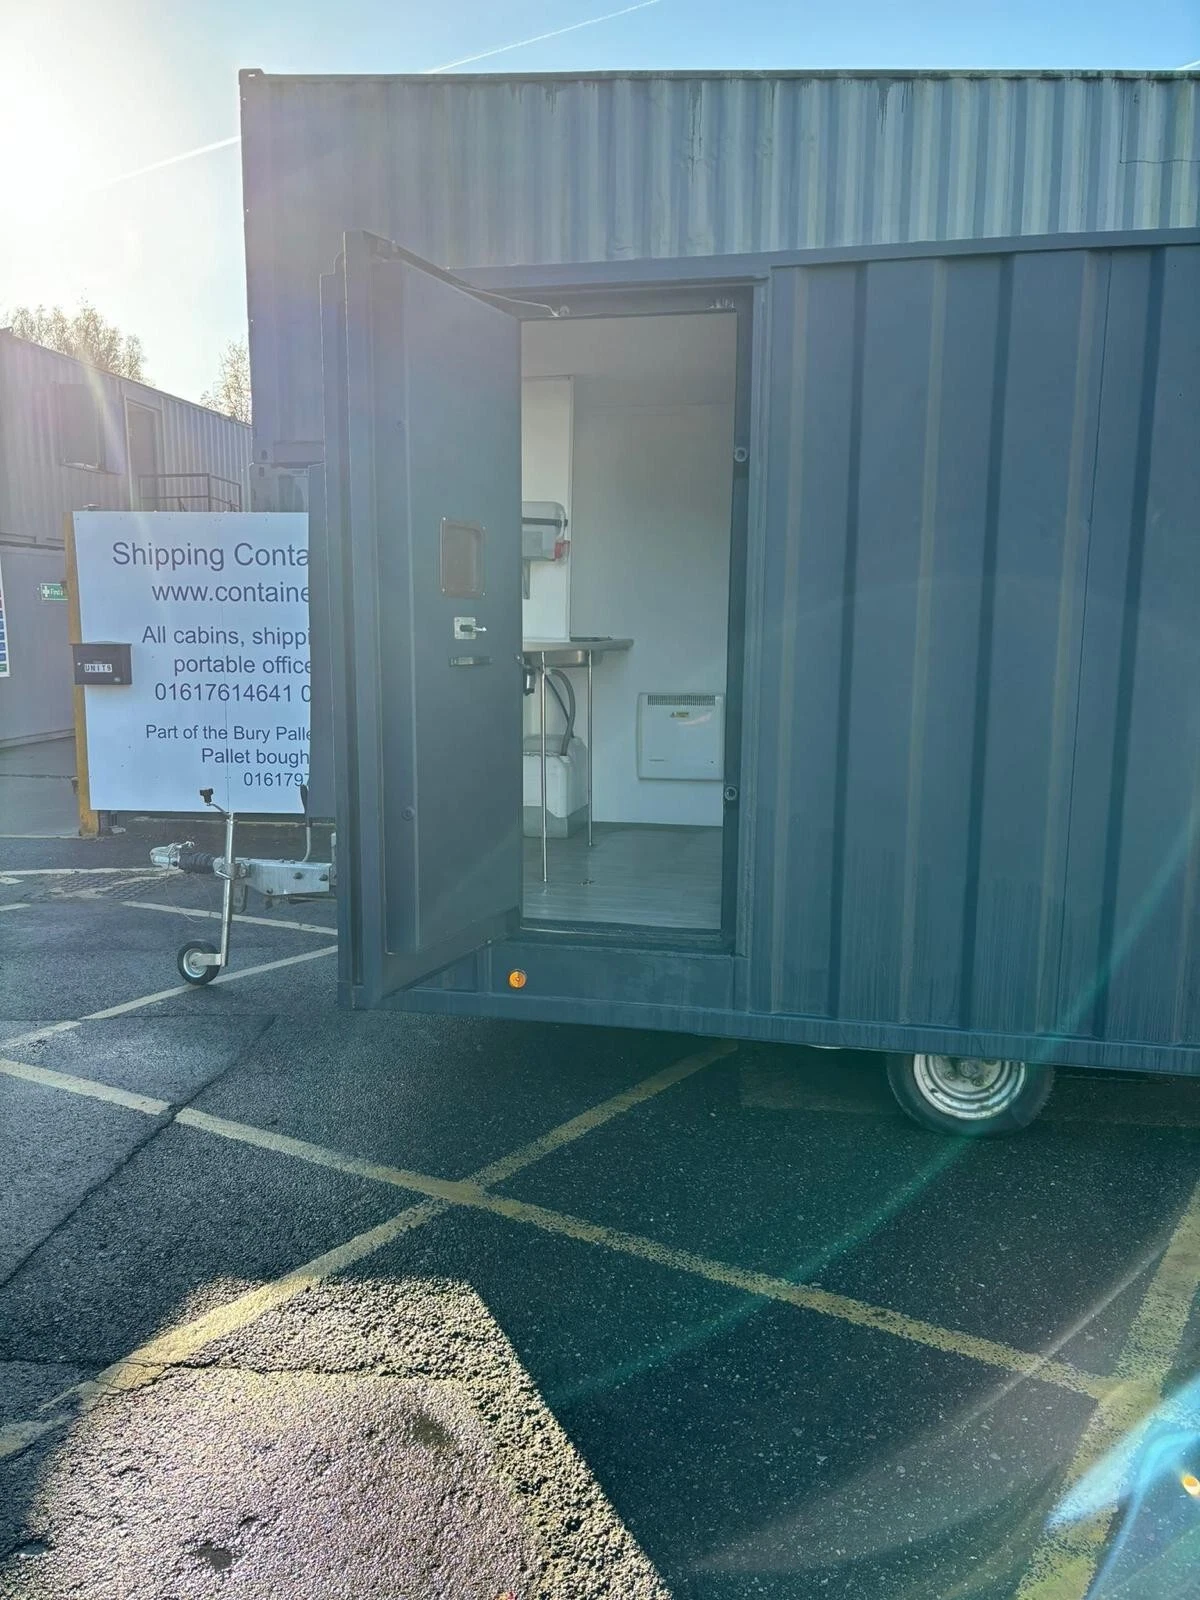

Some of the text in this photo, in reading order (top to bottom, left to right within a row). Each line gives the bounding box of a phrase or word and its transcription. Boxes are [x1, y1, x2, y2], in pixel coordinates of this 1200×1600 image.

[112, 541, 309, 572] Shipping Conta
[151, 581, 310, 603] www.containe
[142, 625, 166, 644] All
[173, 625, 245, 648] cabins,
[85, 664, 112, 672] UNITS
[174, 655, 256, 677] portable
[155, 683, 291, 702] 01617614641
[145, 724, 178, 740] Part
[183, 724, 199, 740] of
[203, 725, 228, 740] the
[233, 725, 271, 744] Bury
[201, 748, 250, 764] Pallet
